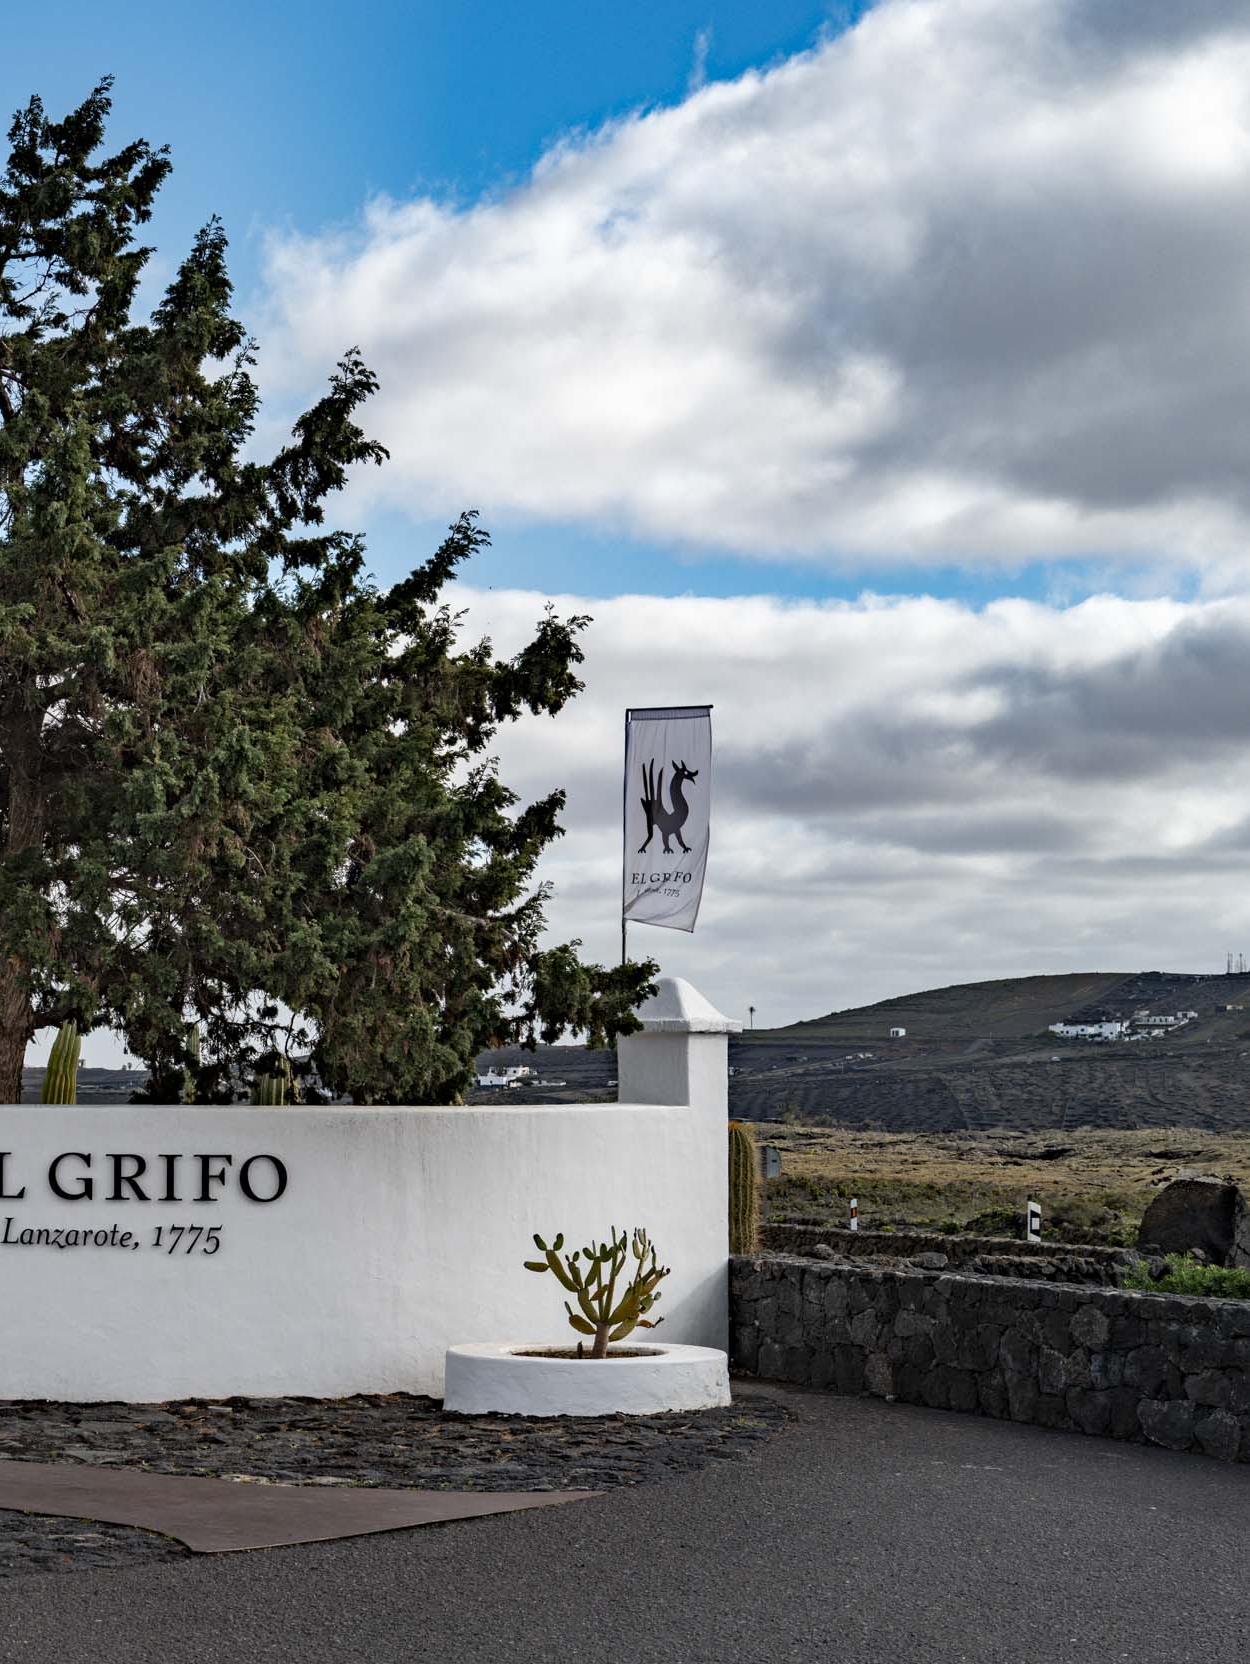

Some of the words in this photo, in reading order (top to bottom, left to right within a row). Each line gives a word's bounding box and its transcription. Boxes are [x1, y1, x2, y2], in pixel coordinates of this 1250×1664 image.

[631, 872, 646, 884] EL
[650, 871, 692, 883] GRFO
[47, 1151, 289, 1203] GRIFO
[0, 1216, 141, 1251] Lanzarote,
[151, 1223, 224, 1255] 1775
